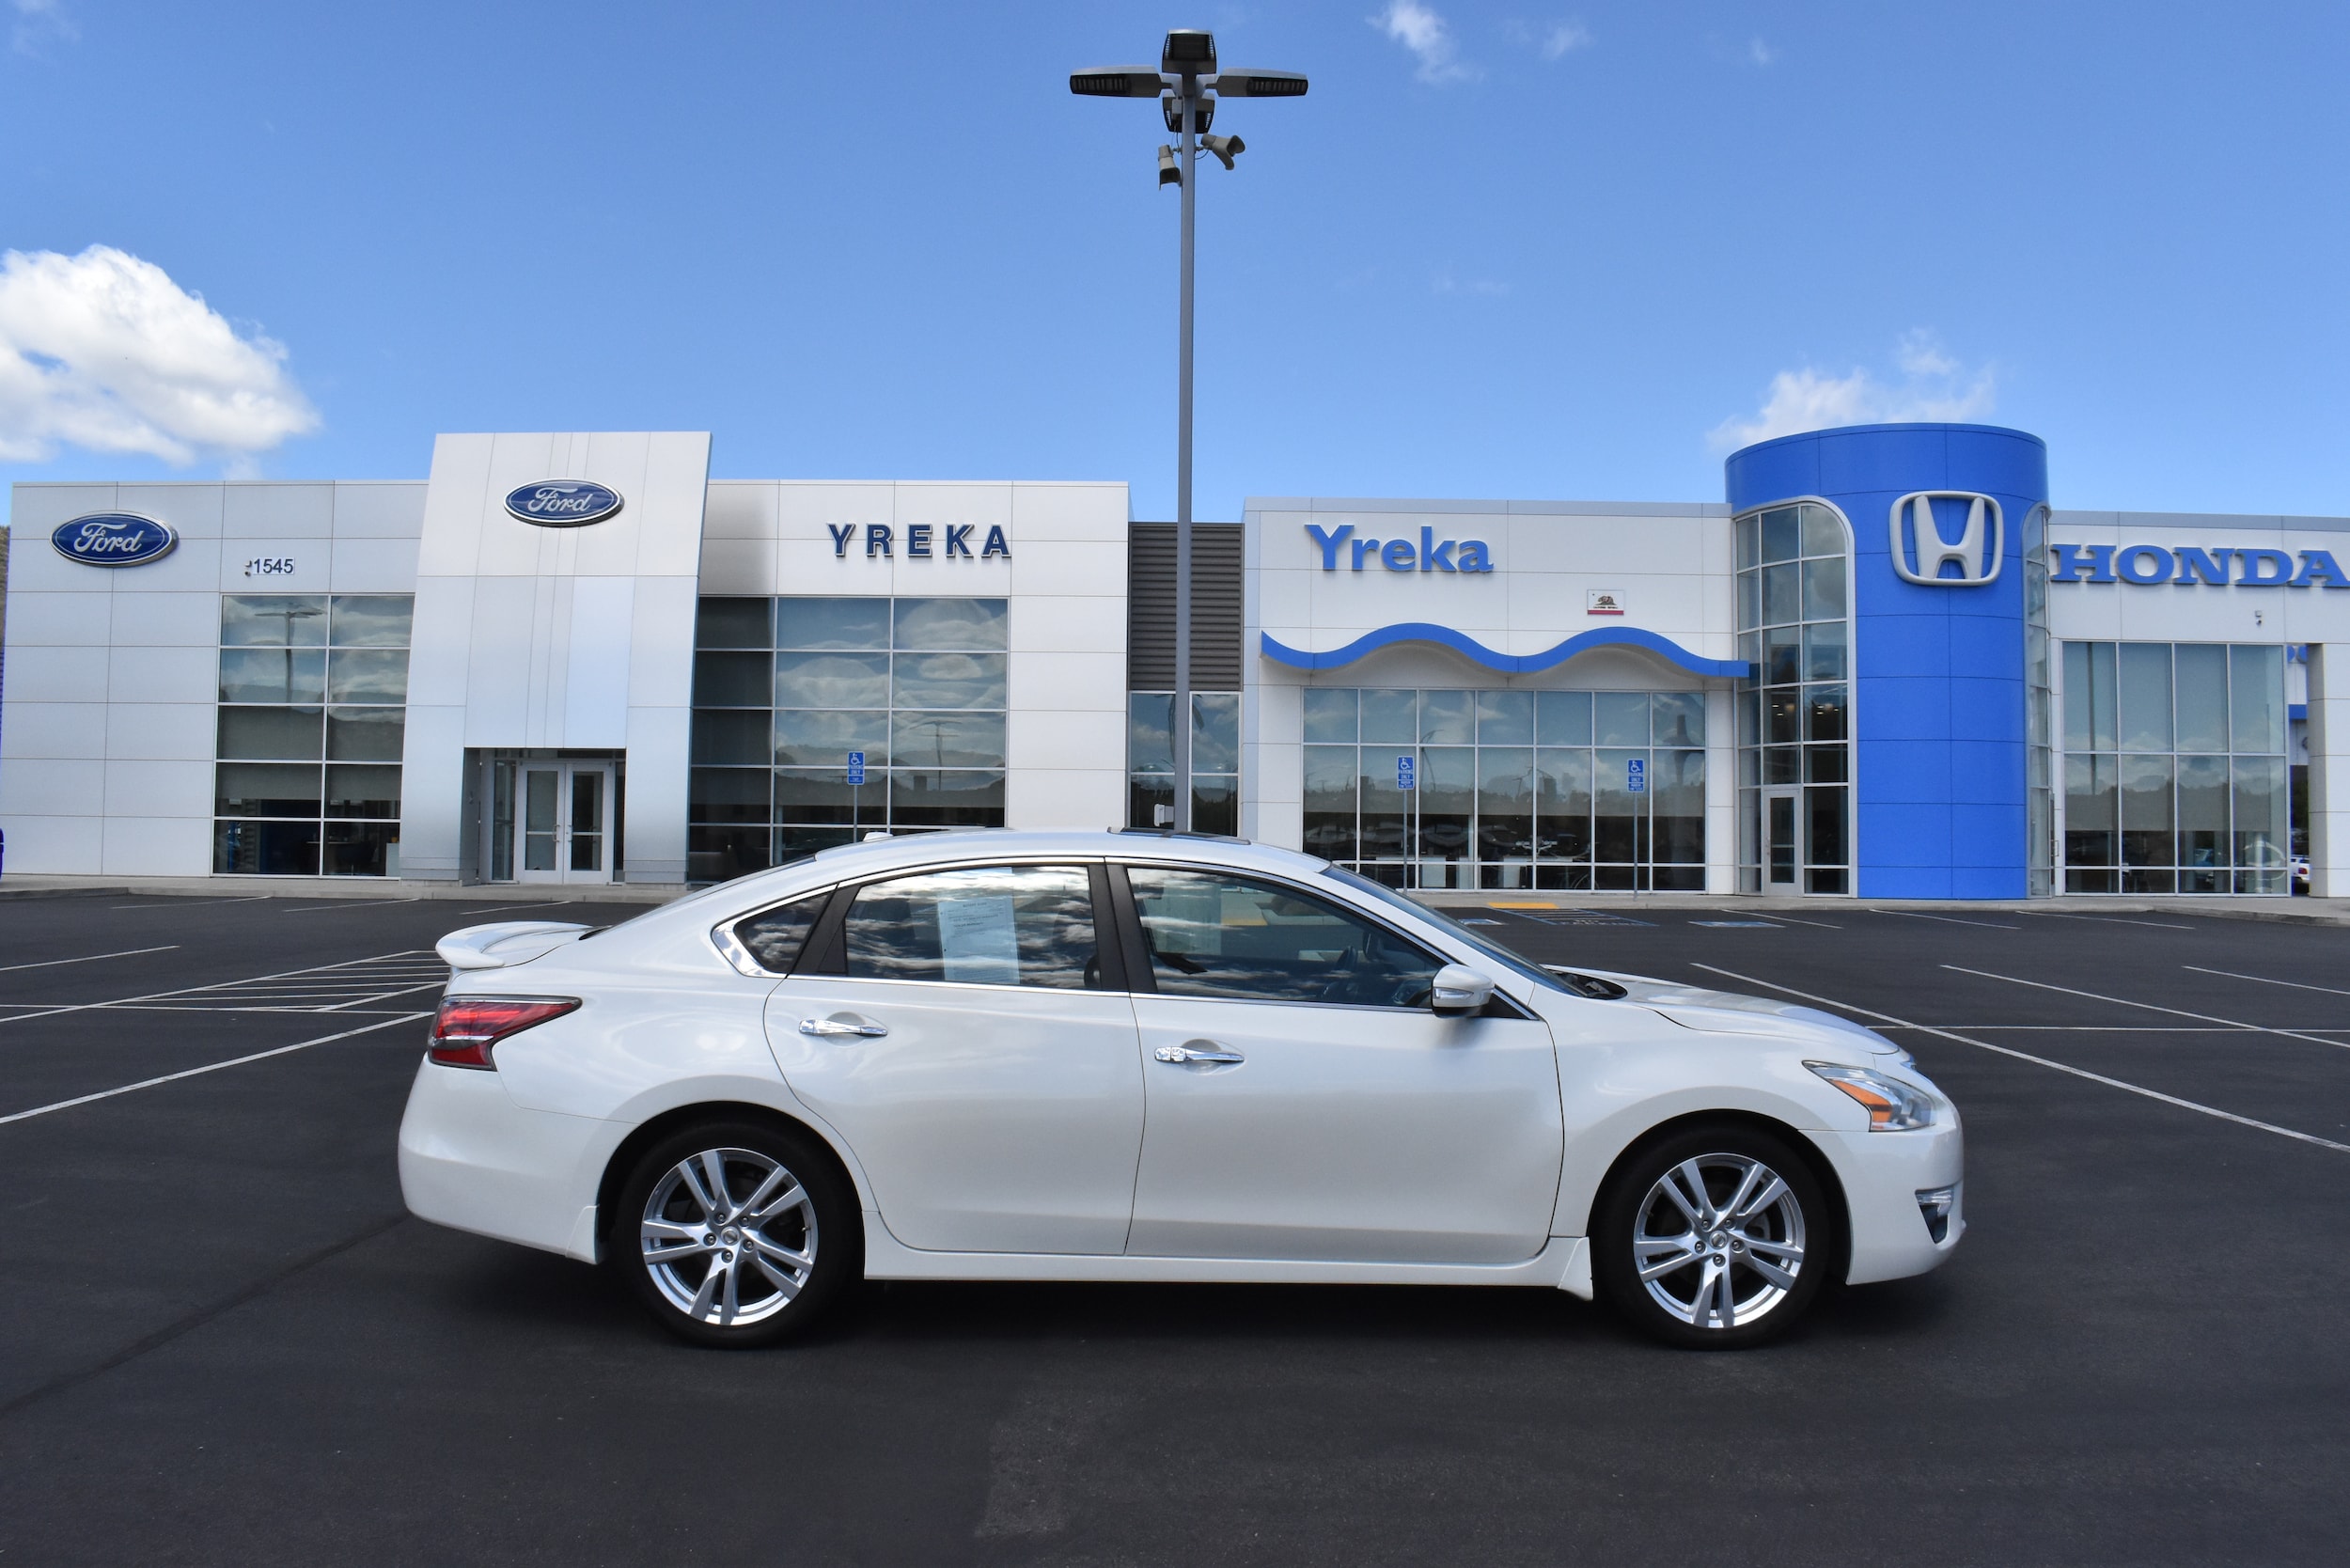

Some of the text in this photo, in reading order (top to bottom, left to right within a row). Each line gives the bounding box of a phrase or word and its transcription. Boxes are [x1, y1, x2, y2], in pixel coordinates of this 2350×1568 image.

[527, 487, 593, 512] Ford
[73, 523, 145, 553] Ford
[826, 523, 1011, 558] YREKA
[1304, 524, 1495, 573] Yreka
[254, 558, 294, 573] 1545
[2046, 543, 2350, 588] HONDA
